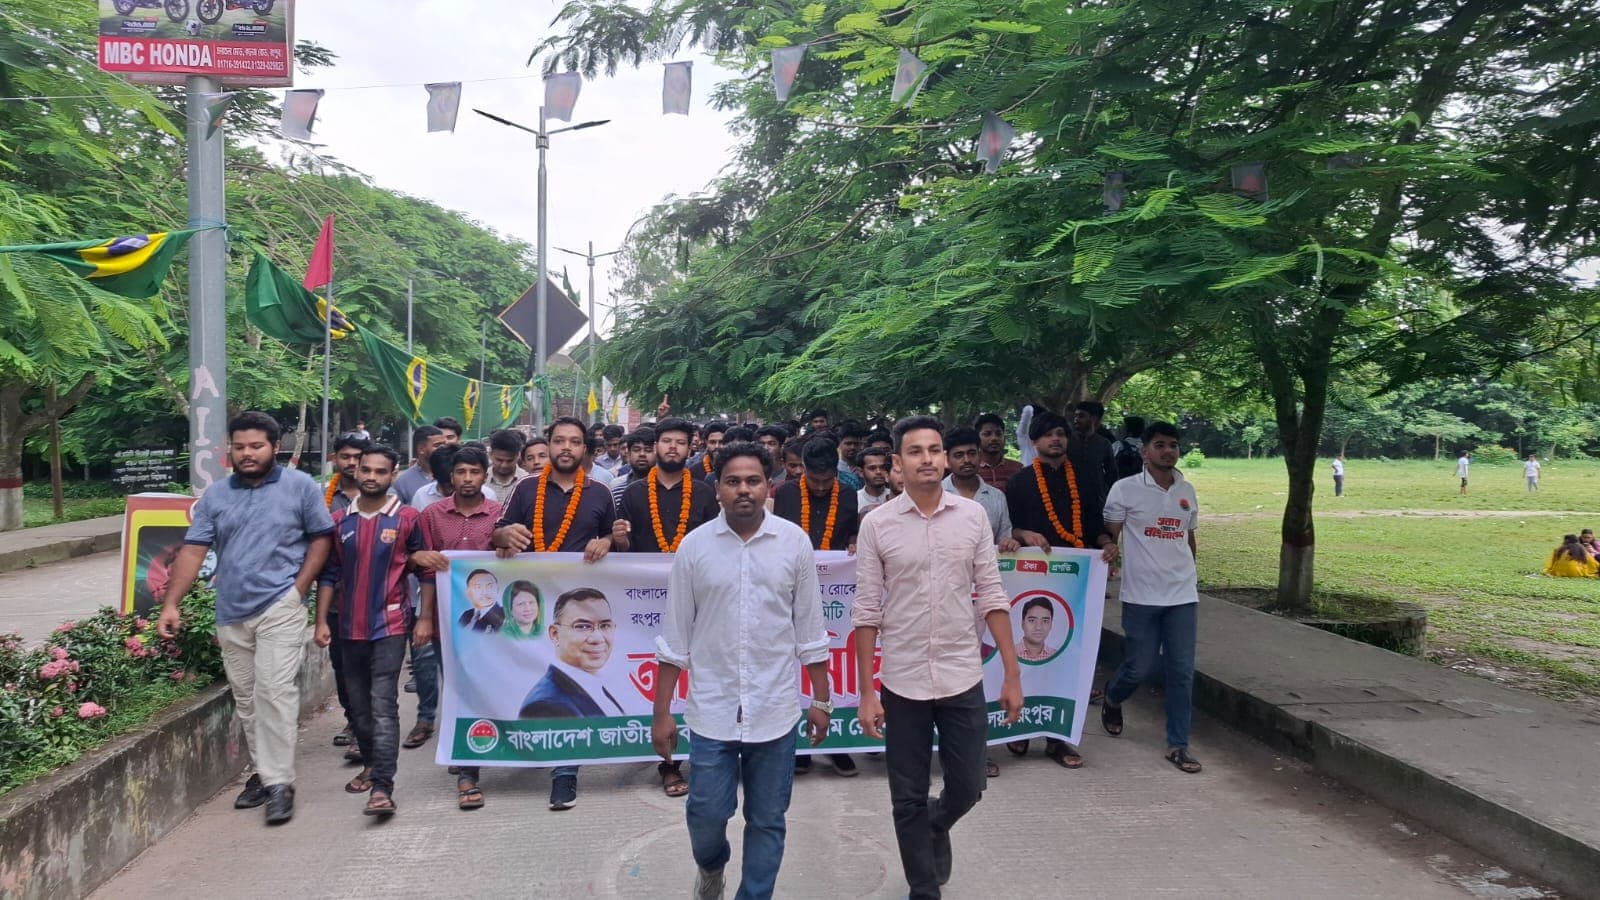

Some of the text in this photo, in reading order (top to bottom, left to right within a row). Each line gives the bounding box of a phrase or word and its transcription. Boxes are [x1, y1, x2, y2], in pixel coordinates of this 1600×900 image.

[104, 41, 213, 67] MBC HONDA
[625, 587, 668, 600] বাংলাদে
[630, 600, 846, 627] রংপুর মিটি
[506, 727, 594, 752] বাংলাদেশ
